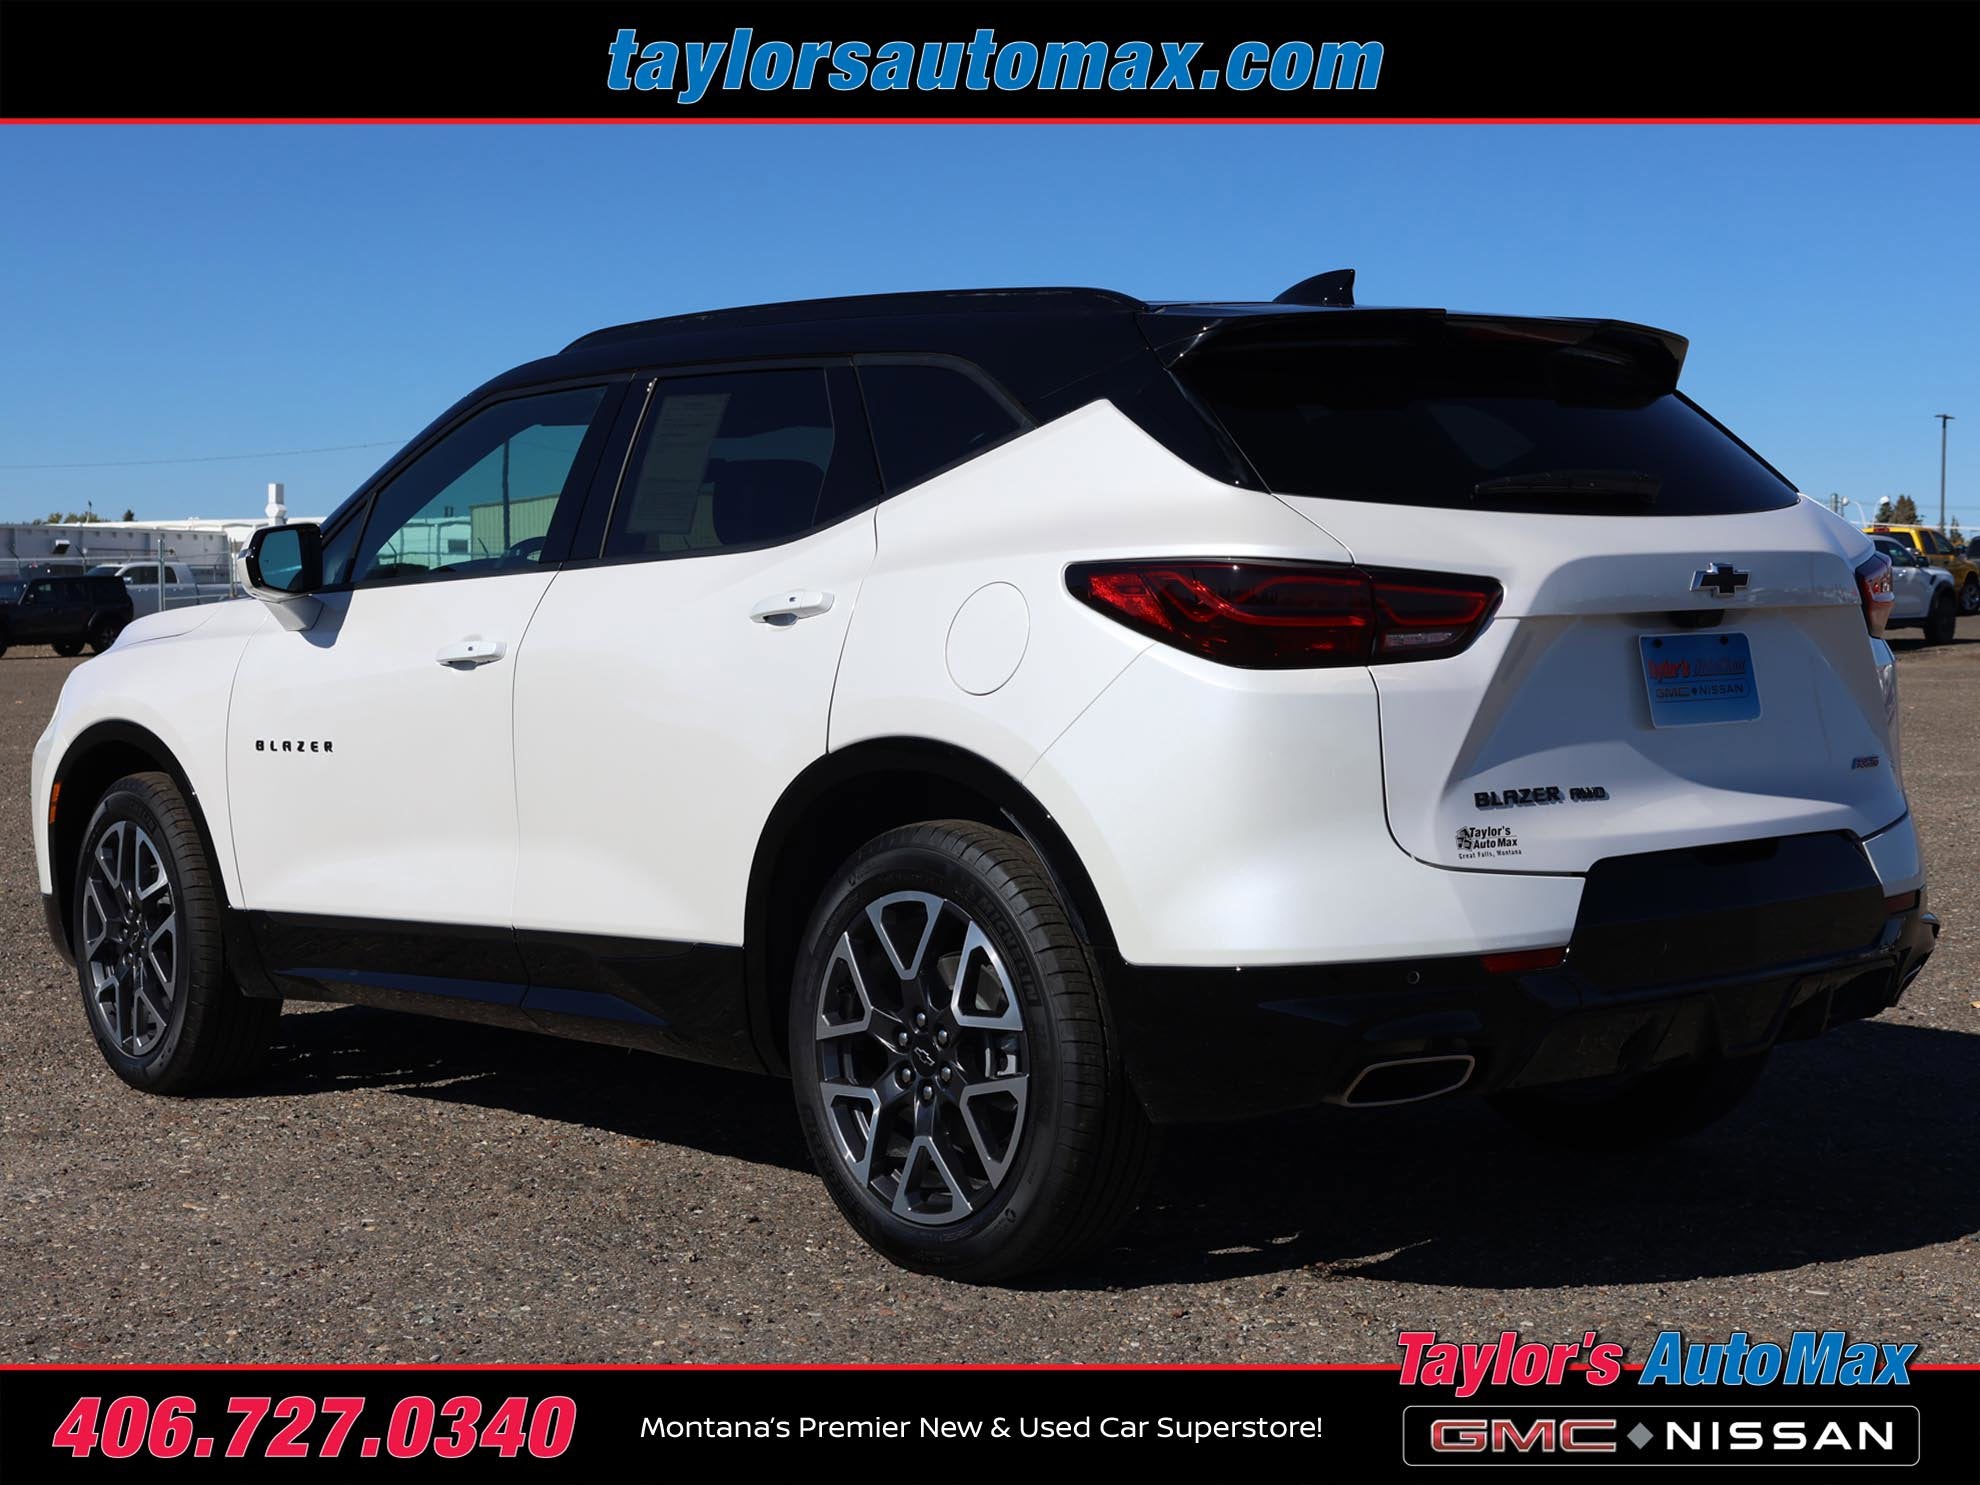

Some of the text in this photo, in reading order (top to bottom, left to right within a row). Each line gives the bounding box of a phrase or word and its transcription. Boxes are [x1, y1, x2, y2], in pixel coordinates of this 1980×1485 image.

[1655, 683, 1744, 699] GMC NISSAN
[255, 740, 333, 752] BLAZER
[1474, 786, 1606, 808] BLAZER AWD
[1469, 825, 1511, 839] Taylor's
